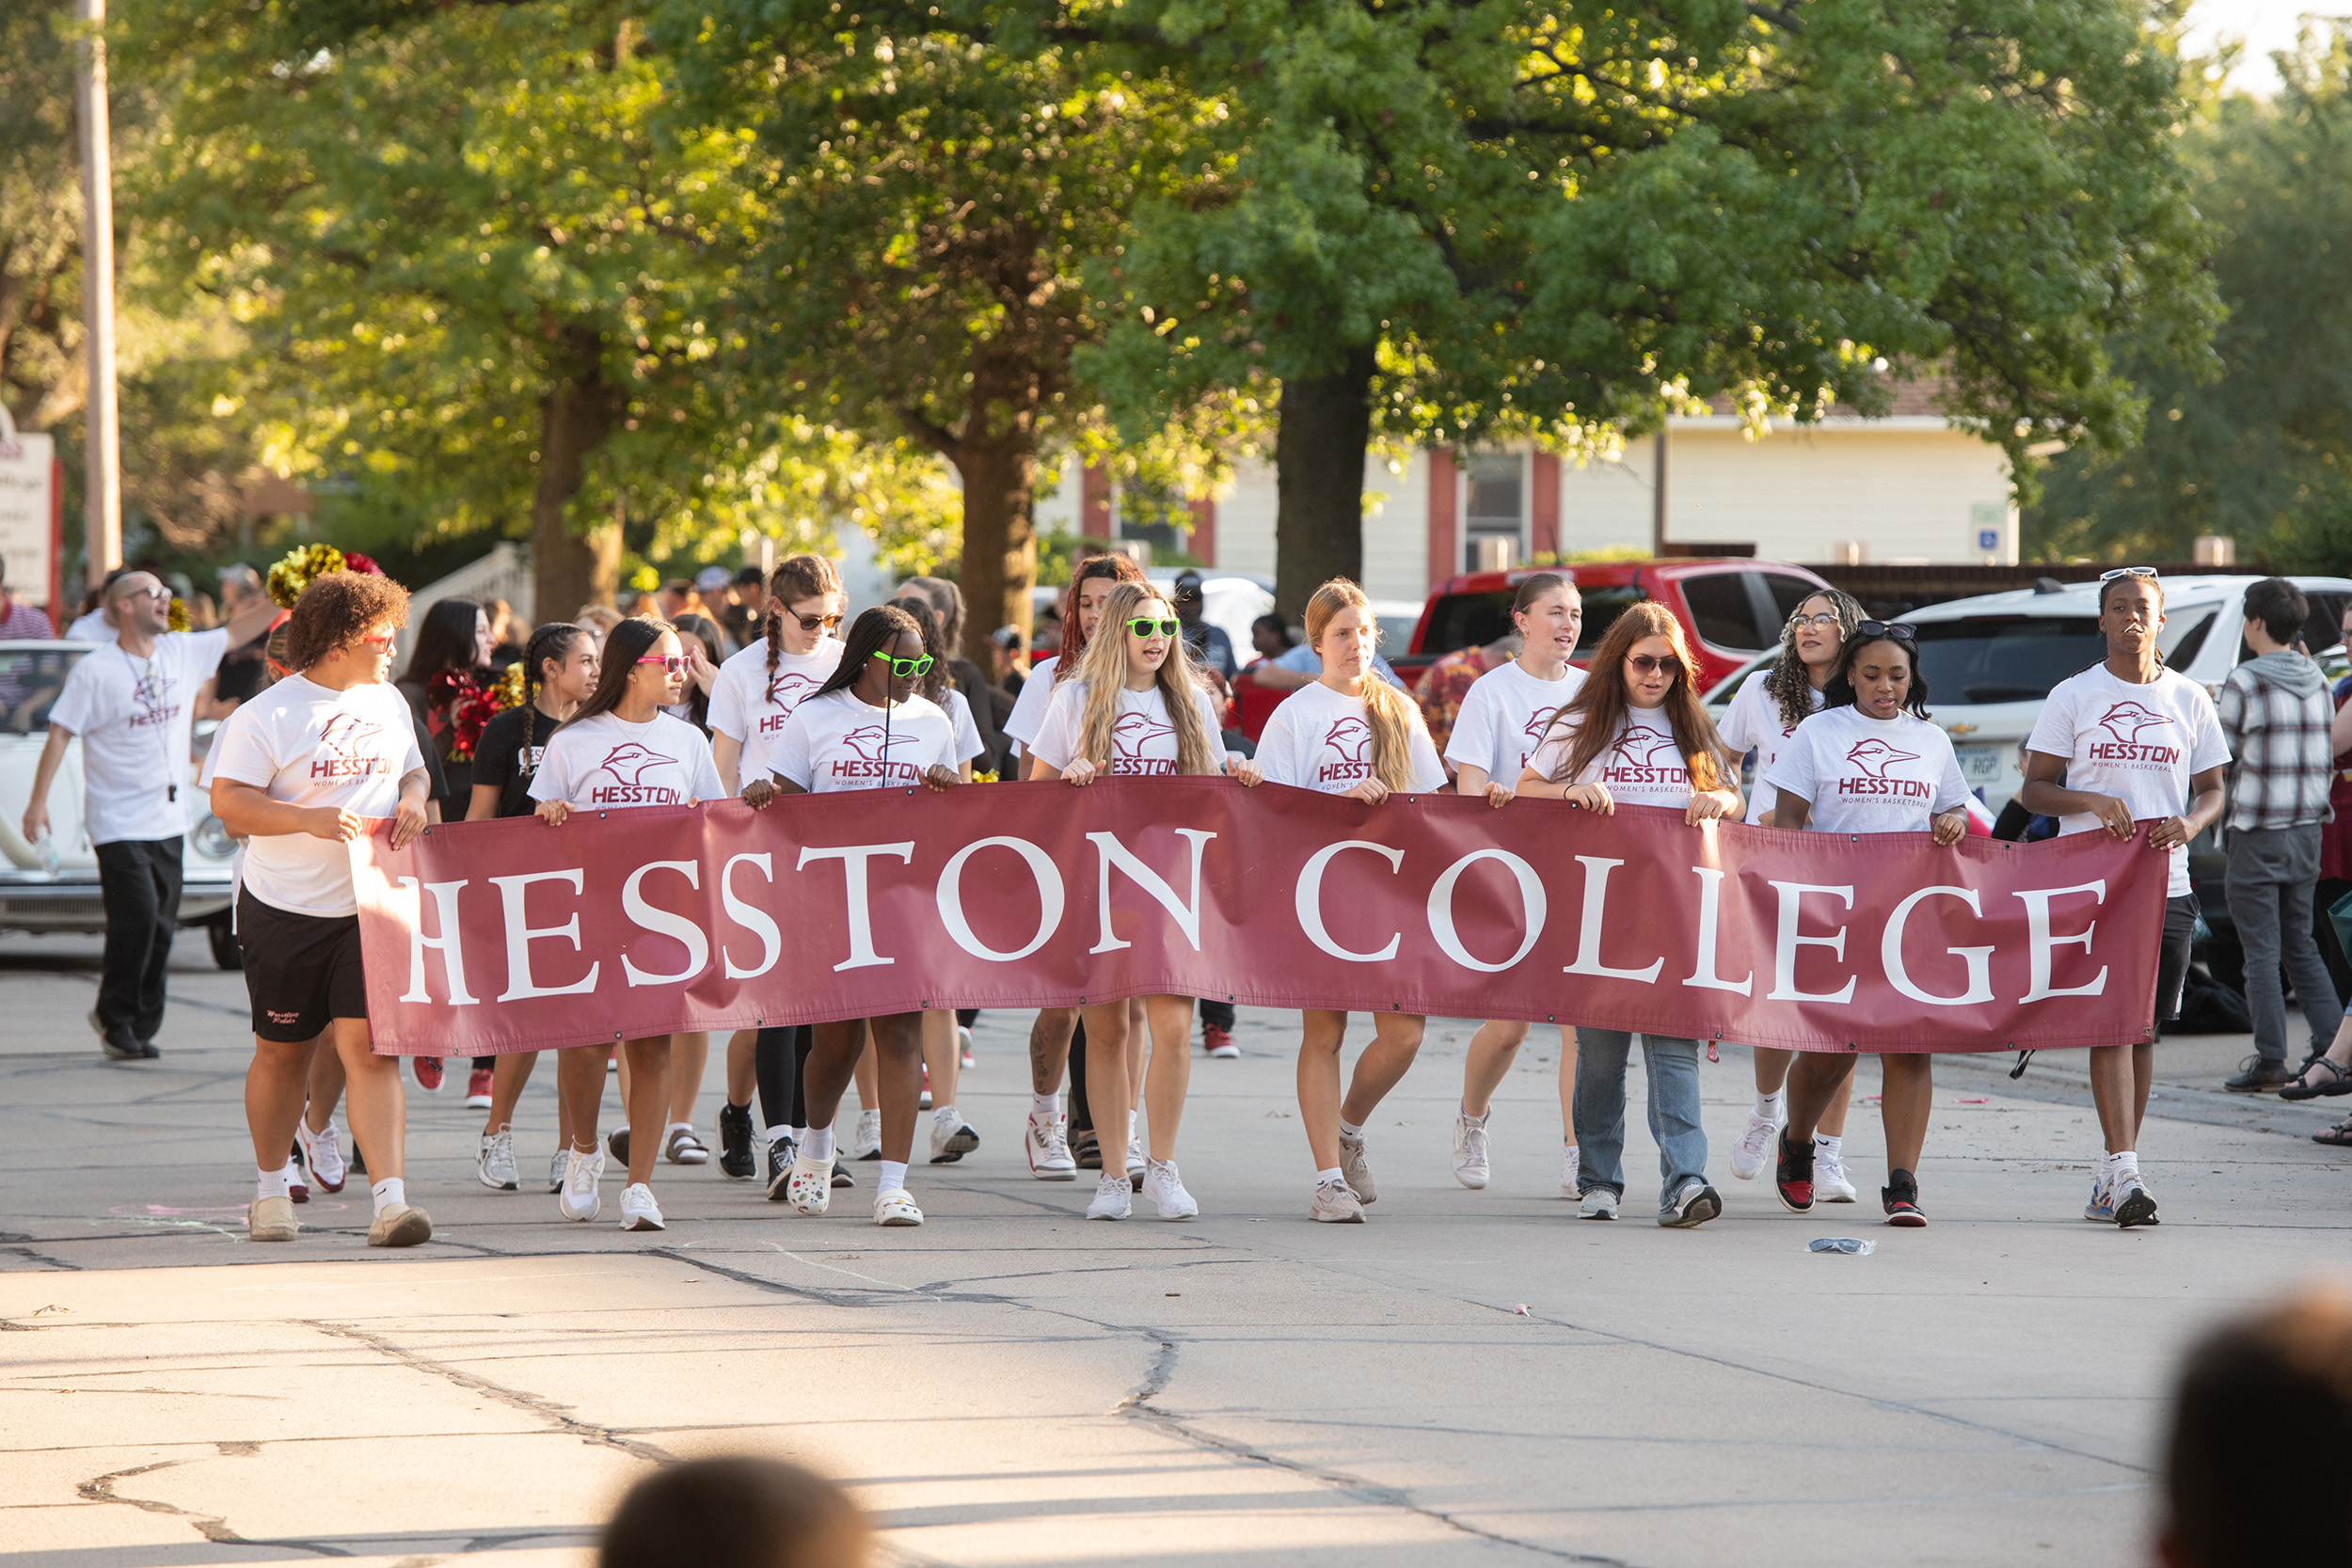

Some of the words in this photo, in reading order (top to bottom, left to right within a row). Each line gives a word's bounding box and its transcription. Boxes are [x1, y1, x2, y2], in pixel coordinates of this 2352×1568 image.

[129, 705, 180, 728] HESST
[2090, 743, 2180, 764] HESSTON
[1112, 758, 1177, 775] ESSTON
[1319, 763, 1371, 783] HESST
[2131, 764, 2174, 772] BASKETBAL
[592, 786, 680, 804] HESSTON
[1649, 785, 1692, 794] BASKETBAL
[1838, 778, 1931, 799] HESSTON
[1883, 798, 1927, 808] BASKETBALL
[398, 827, 1216, 1006] HESSTON
[1295, 840, 2108, 1006] COLLEGE
